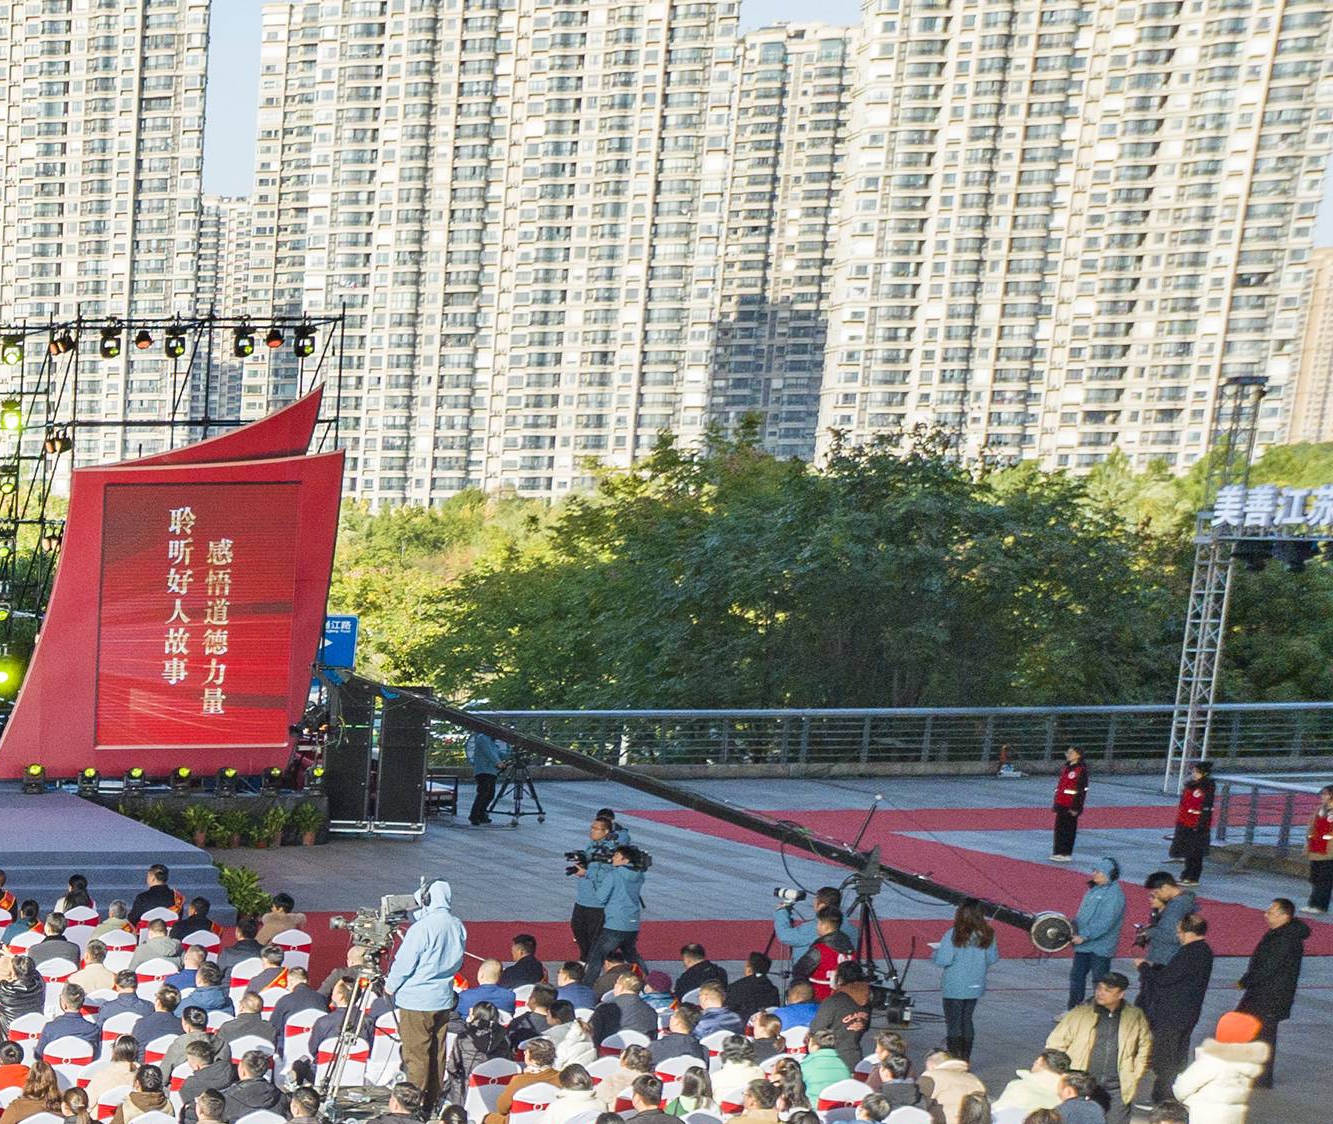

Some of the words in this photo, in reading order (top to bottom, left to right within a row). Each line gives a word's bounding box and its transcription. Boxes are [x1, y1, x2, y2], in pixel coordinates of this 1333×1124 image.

[161, 506, 197, 686] 聆听好人故事
[200, 538, 234, 716] 感悟道德力量
